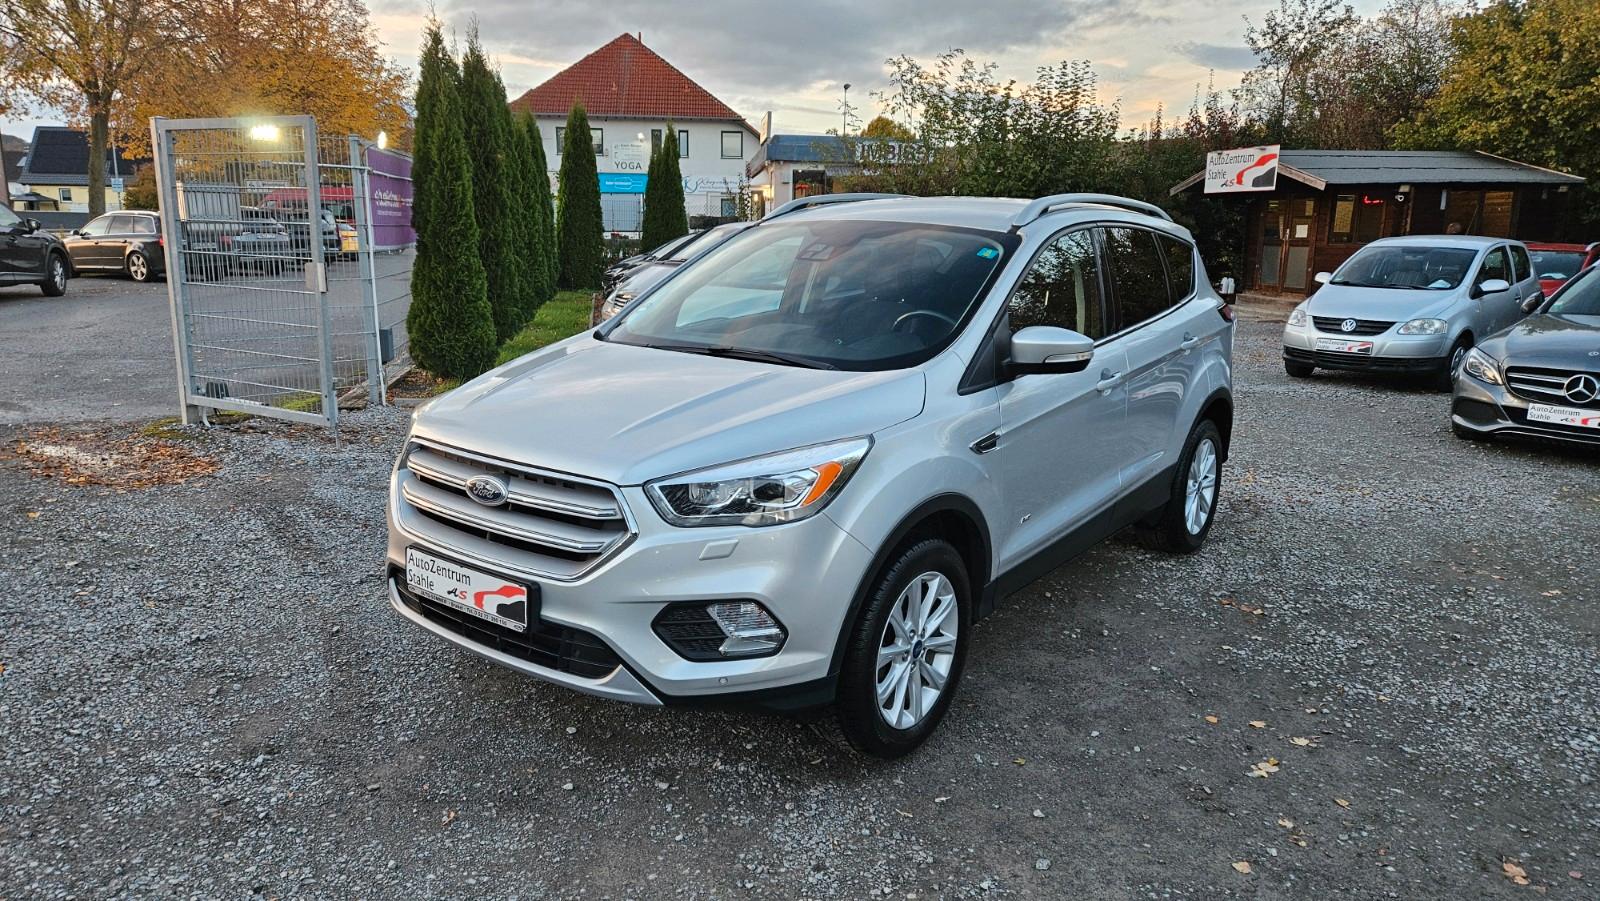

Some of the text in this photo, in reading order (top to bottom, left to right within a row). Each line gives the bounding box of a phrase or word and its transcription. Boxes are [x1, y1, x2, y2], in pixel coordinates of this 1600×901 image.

[614, 161, 642, 170] YOGA
[1209, 153, 1255, 167] AutoZentrum
[472, 480, 498, 499] Ford
[408, 551, 471, 587] AutoZentrum
[408, 568, 435, 591] Stahle
